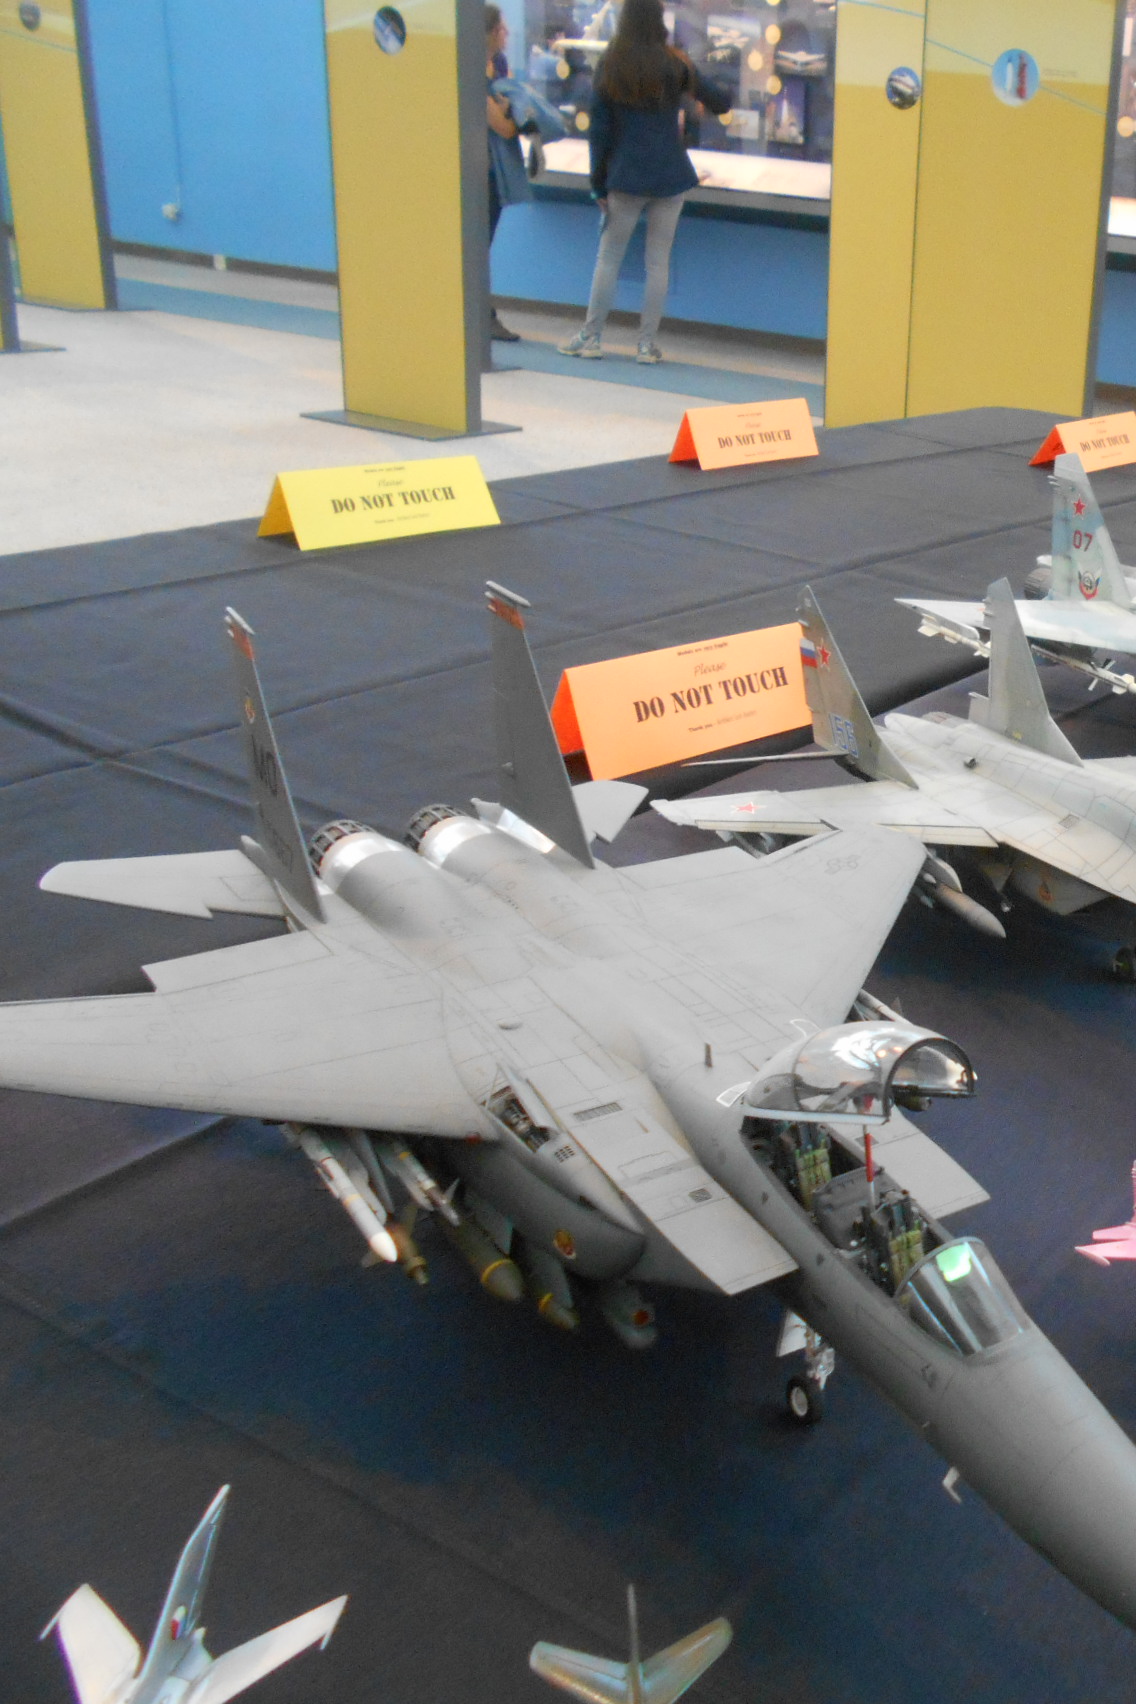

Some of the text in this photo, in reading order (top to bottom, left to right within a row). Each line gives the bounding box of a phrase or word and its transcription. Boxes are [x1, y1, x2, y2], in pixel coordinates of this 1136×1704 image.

[718, 429, 792, 449] DO NOT TOUCH
[1080, 441, 1091, 452] DO
[331, 486, 456, 514] DO NOT TOUCH
[1072, 530, 1093, 551] 07
[694, 661, 727, 678] Please
[633, 697, 665, 723] DO
[670, 684, 715, 714] NOT
[719, 667, 790, 701] TOUCH
